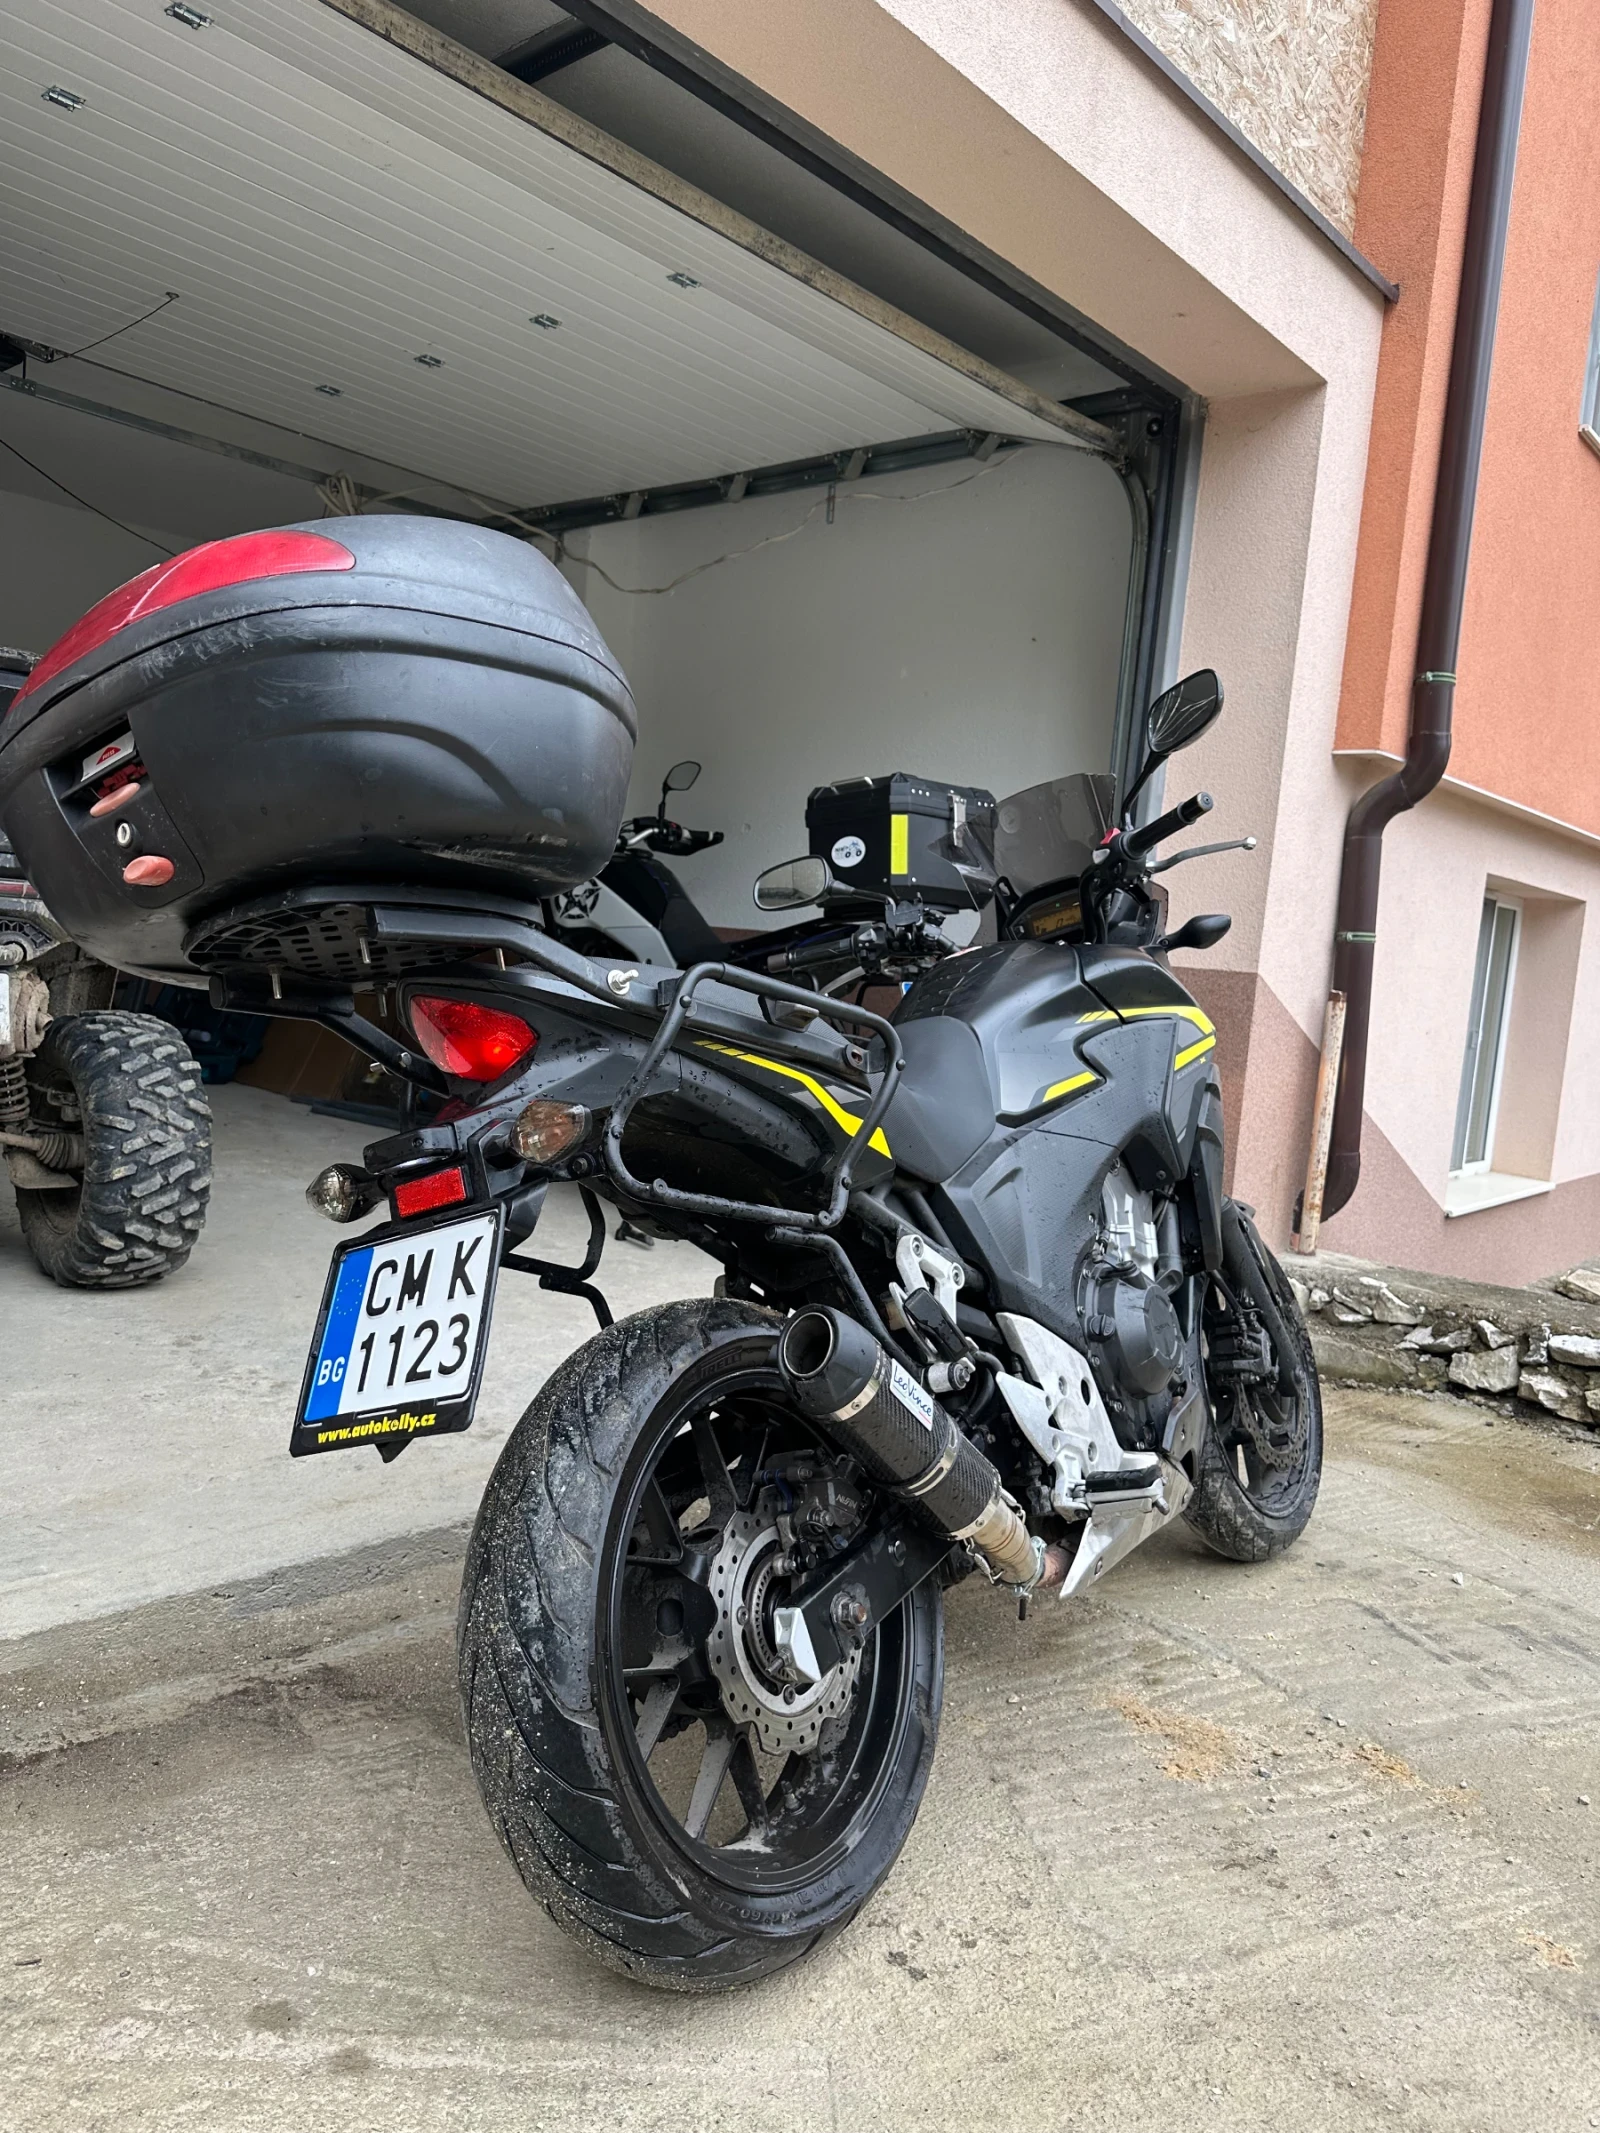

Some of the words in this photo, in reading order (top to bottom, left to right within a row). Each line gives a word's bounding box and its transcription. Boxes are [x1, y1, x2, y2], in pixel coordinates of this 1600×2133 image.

[365, 1249, 434, 1317] CM
[447, 1235, 484, 1300] K
[317, 1356, 345, 1386] BG
[357, 1313, 470, 1393] 1123
[894, 1366, 932, 1417] LeoVince
